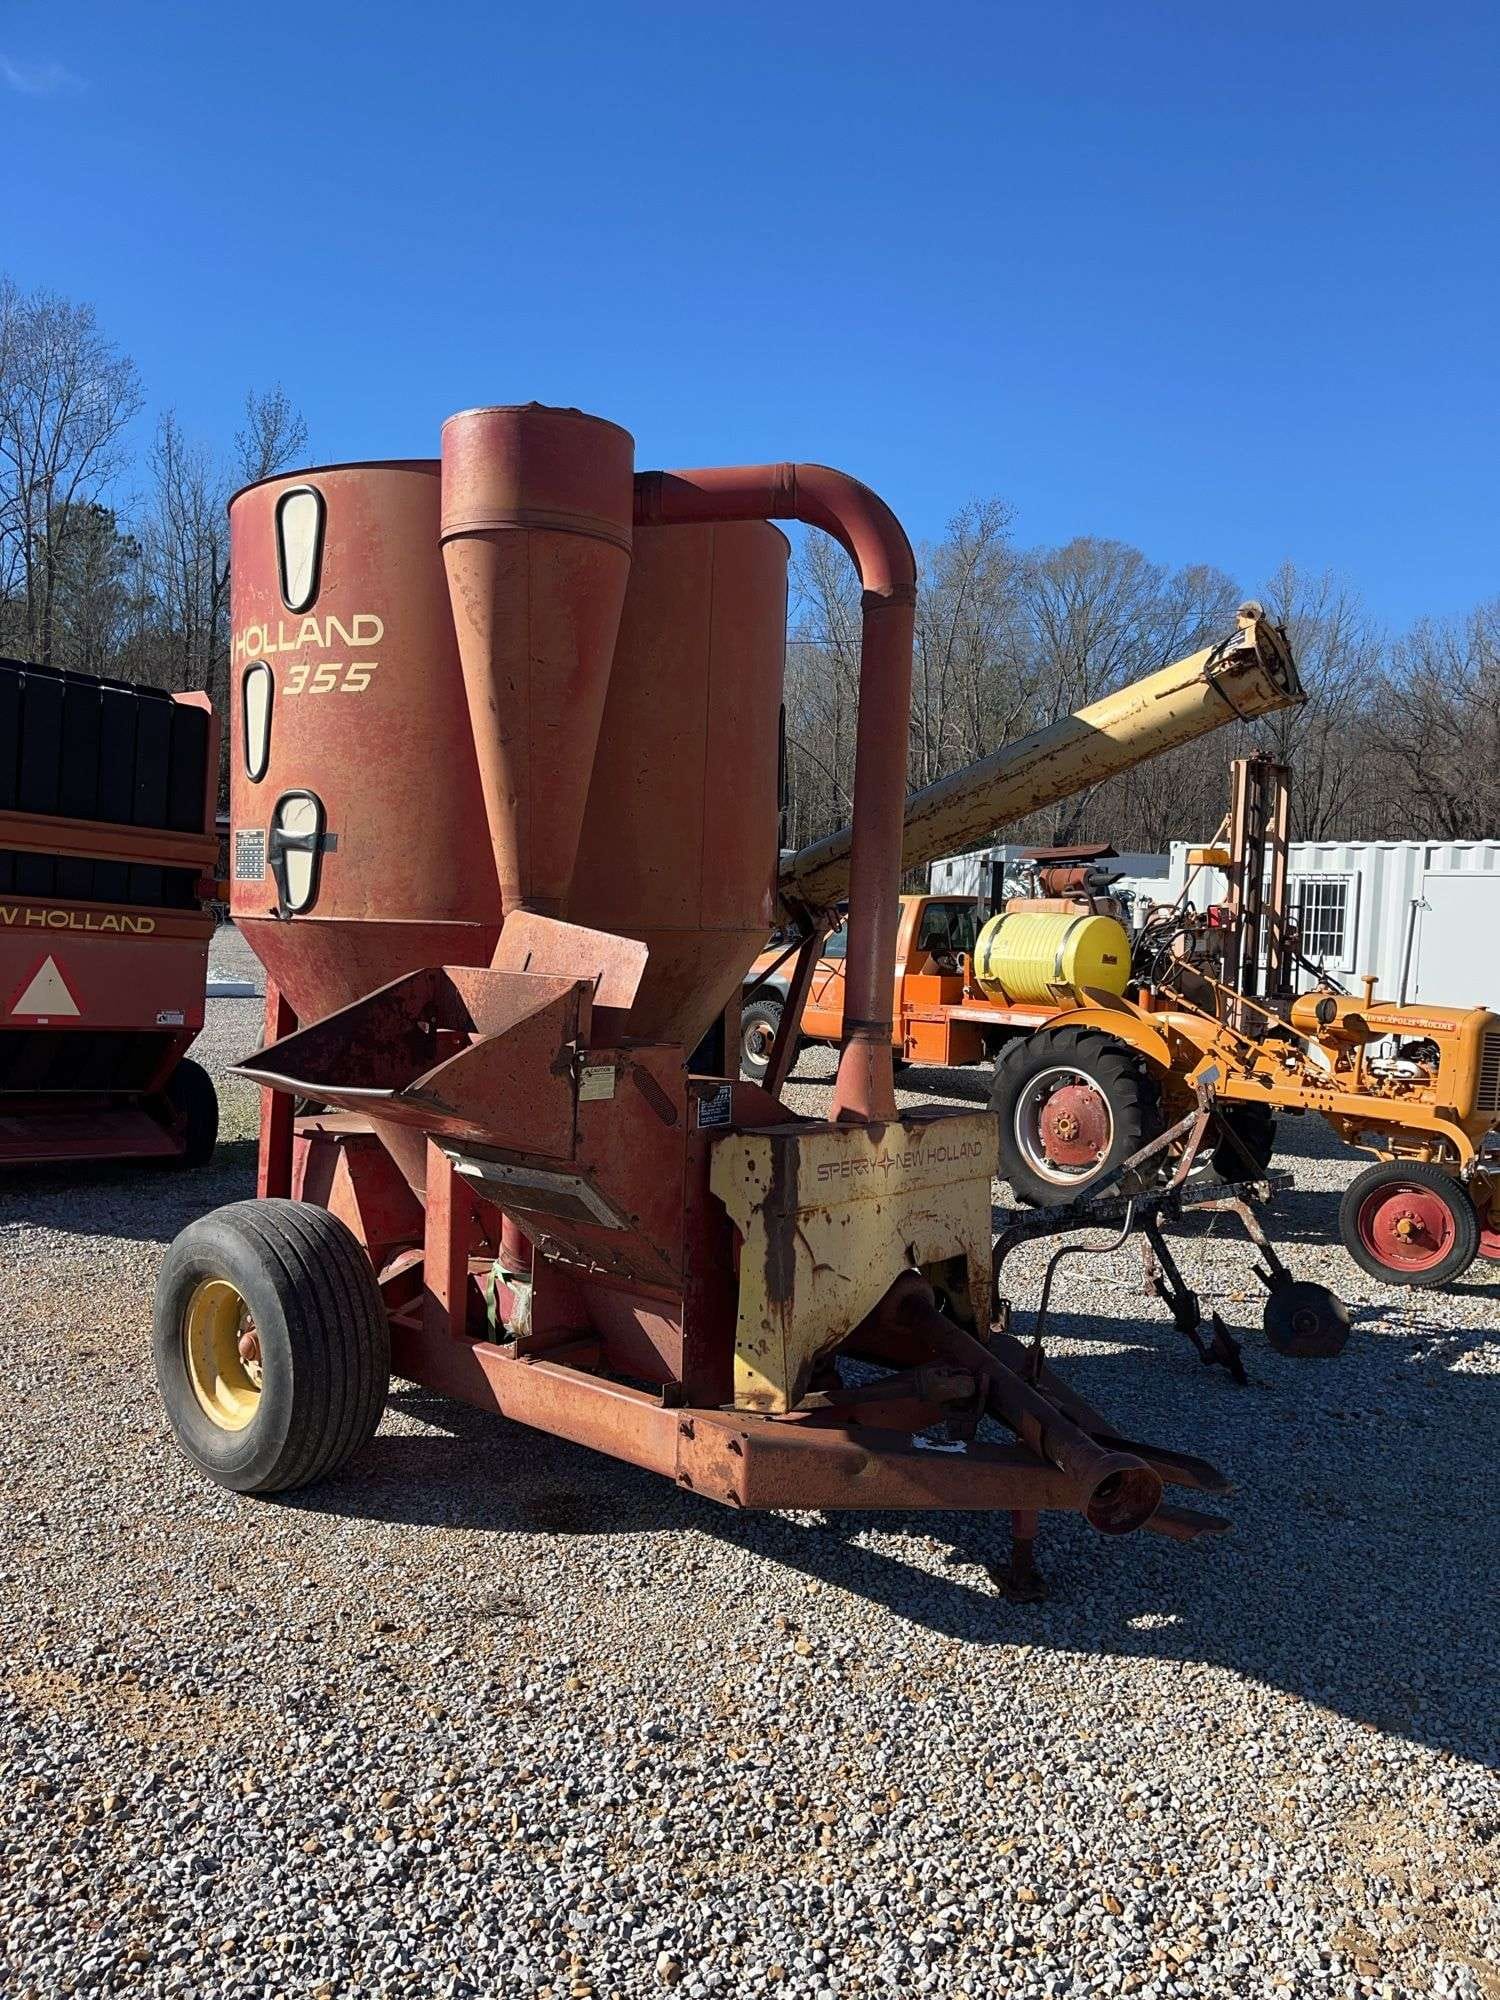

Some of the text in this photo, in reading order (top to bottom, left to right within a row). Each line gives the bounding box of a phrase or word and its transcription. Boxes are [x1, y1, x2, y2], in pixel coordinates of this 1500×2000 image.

[235, 614, 385, 663] HOLLAND
[282, 662, 379, 696] 355
[25, 908, 156, 934] HOLLAND
[817, 1141, 982, 1182] SPERRY NEW HOLLAND
